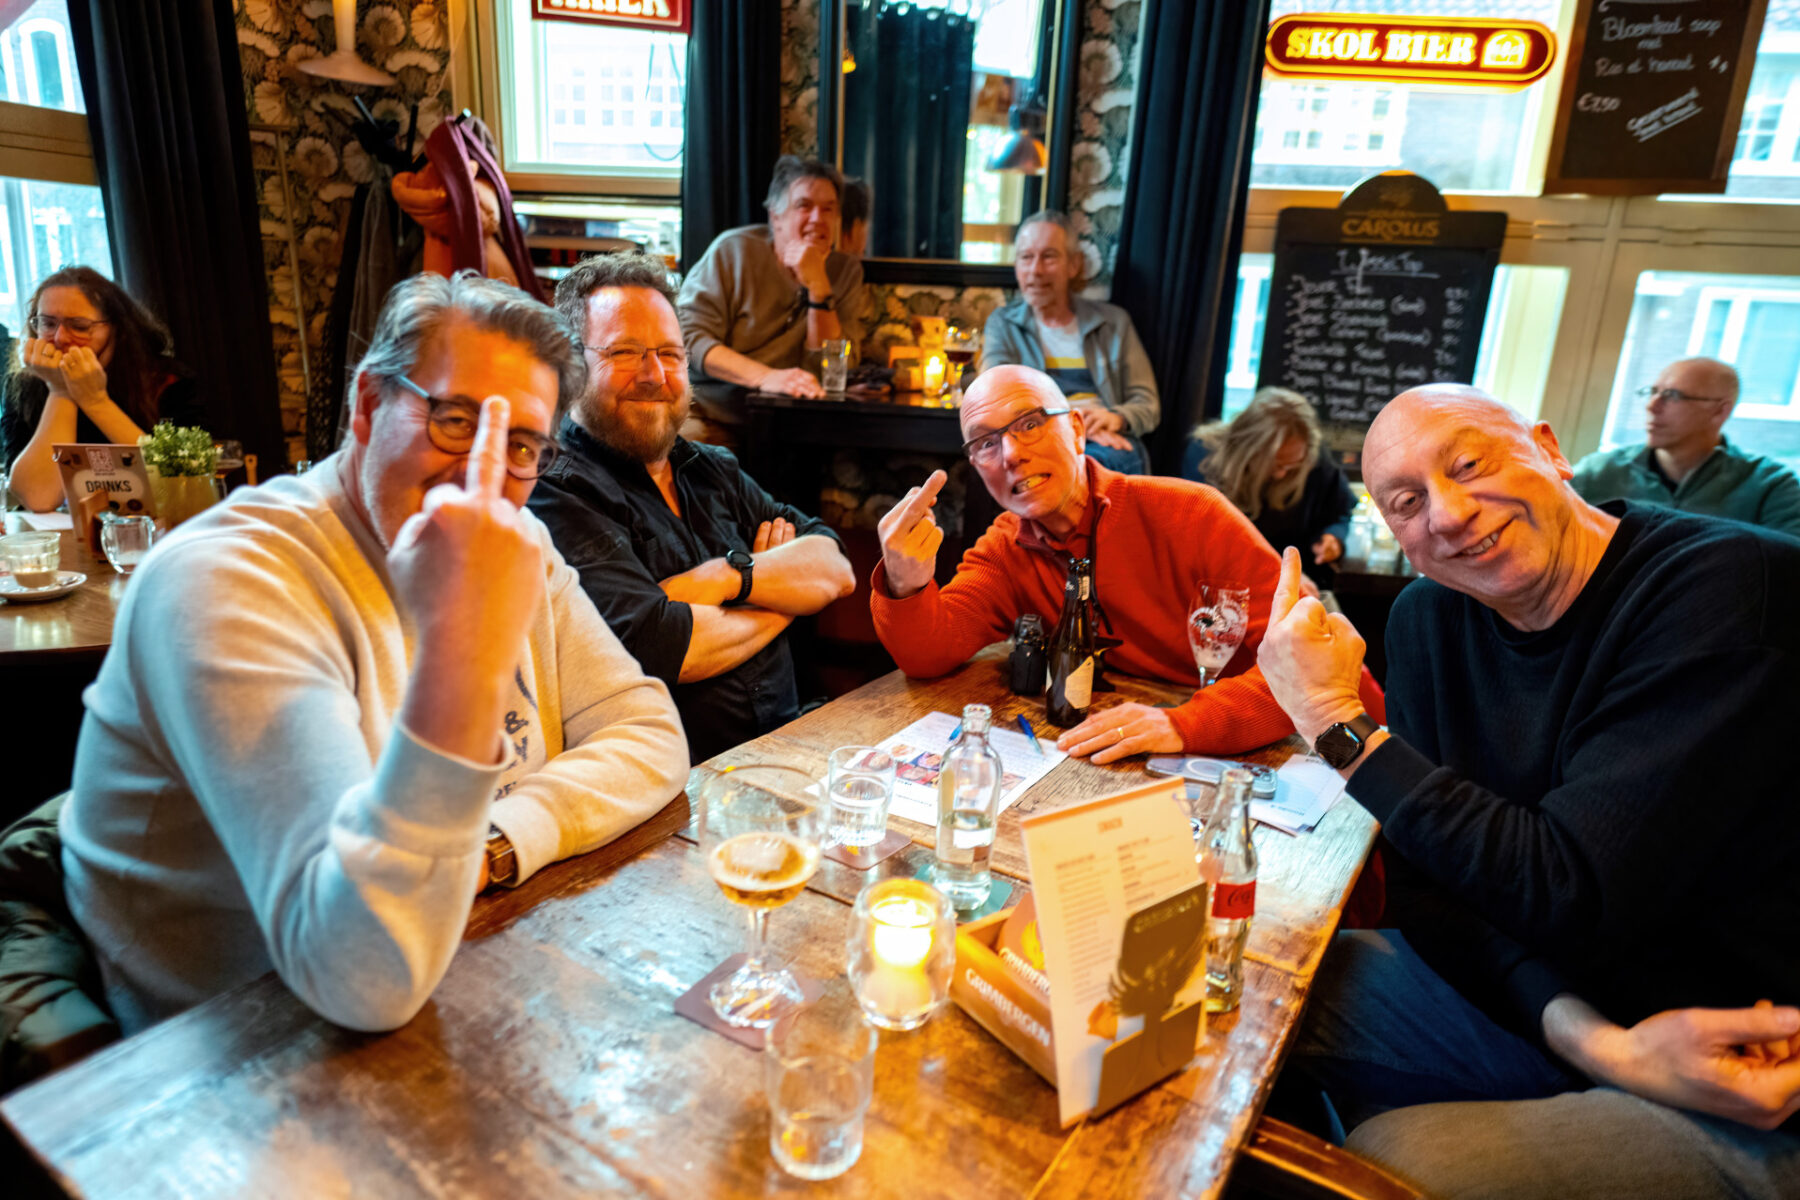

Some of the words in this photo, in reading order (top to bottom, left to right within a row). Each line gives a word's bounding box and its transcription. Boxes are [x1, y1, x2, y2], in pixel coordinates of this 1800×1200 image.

[1287, 28, 1381, 60] SKOL
[1382, 30, 1478, 64] BIER
[1341, 219, 1440, 241] CAROLUS
[85, 480, 132, 493] DRINKS
